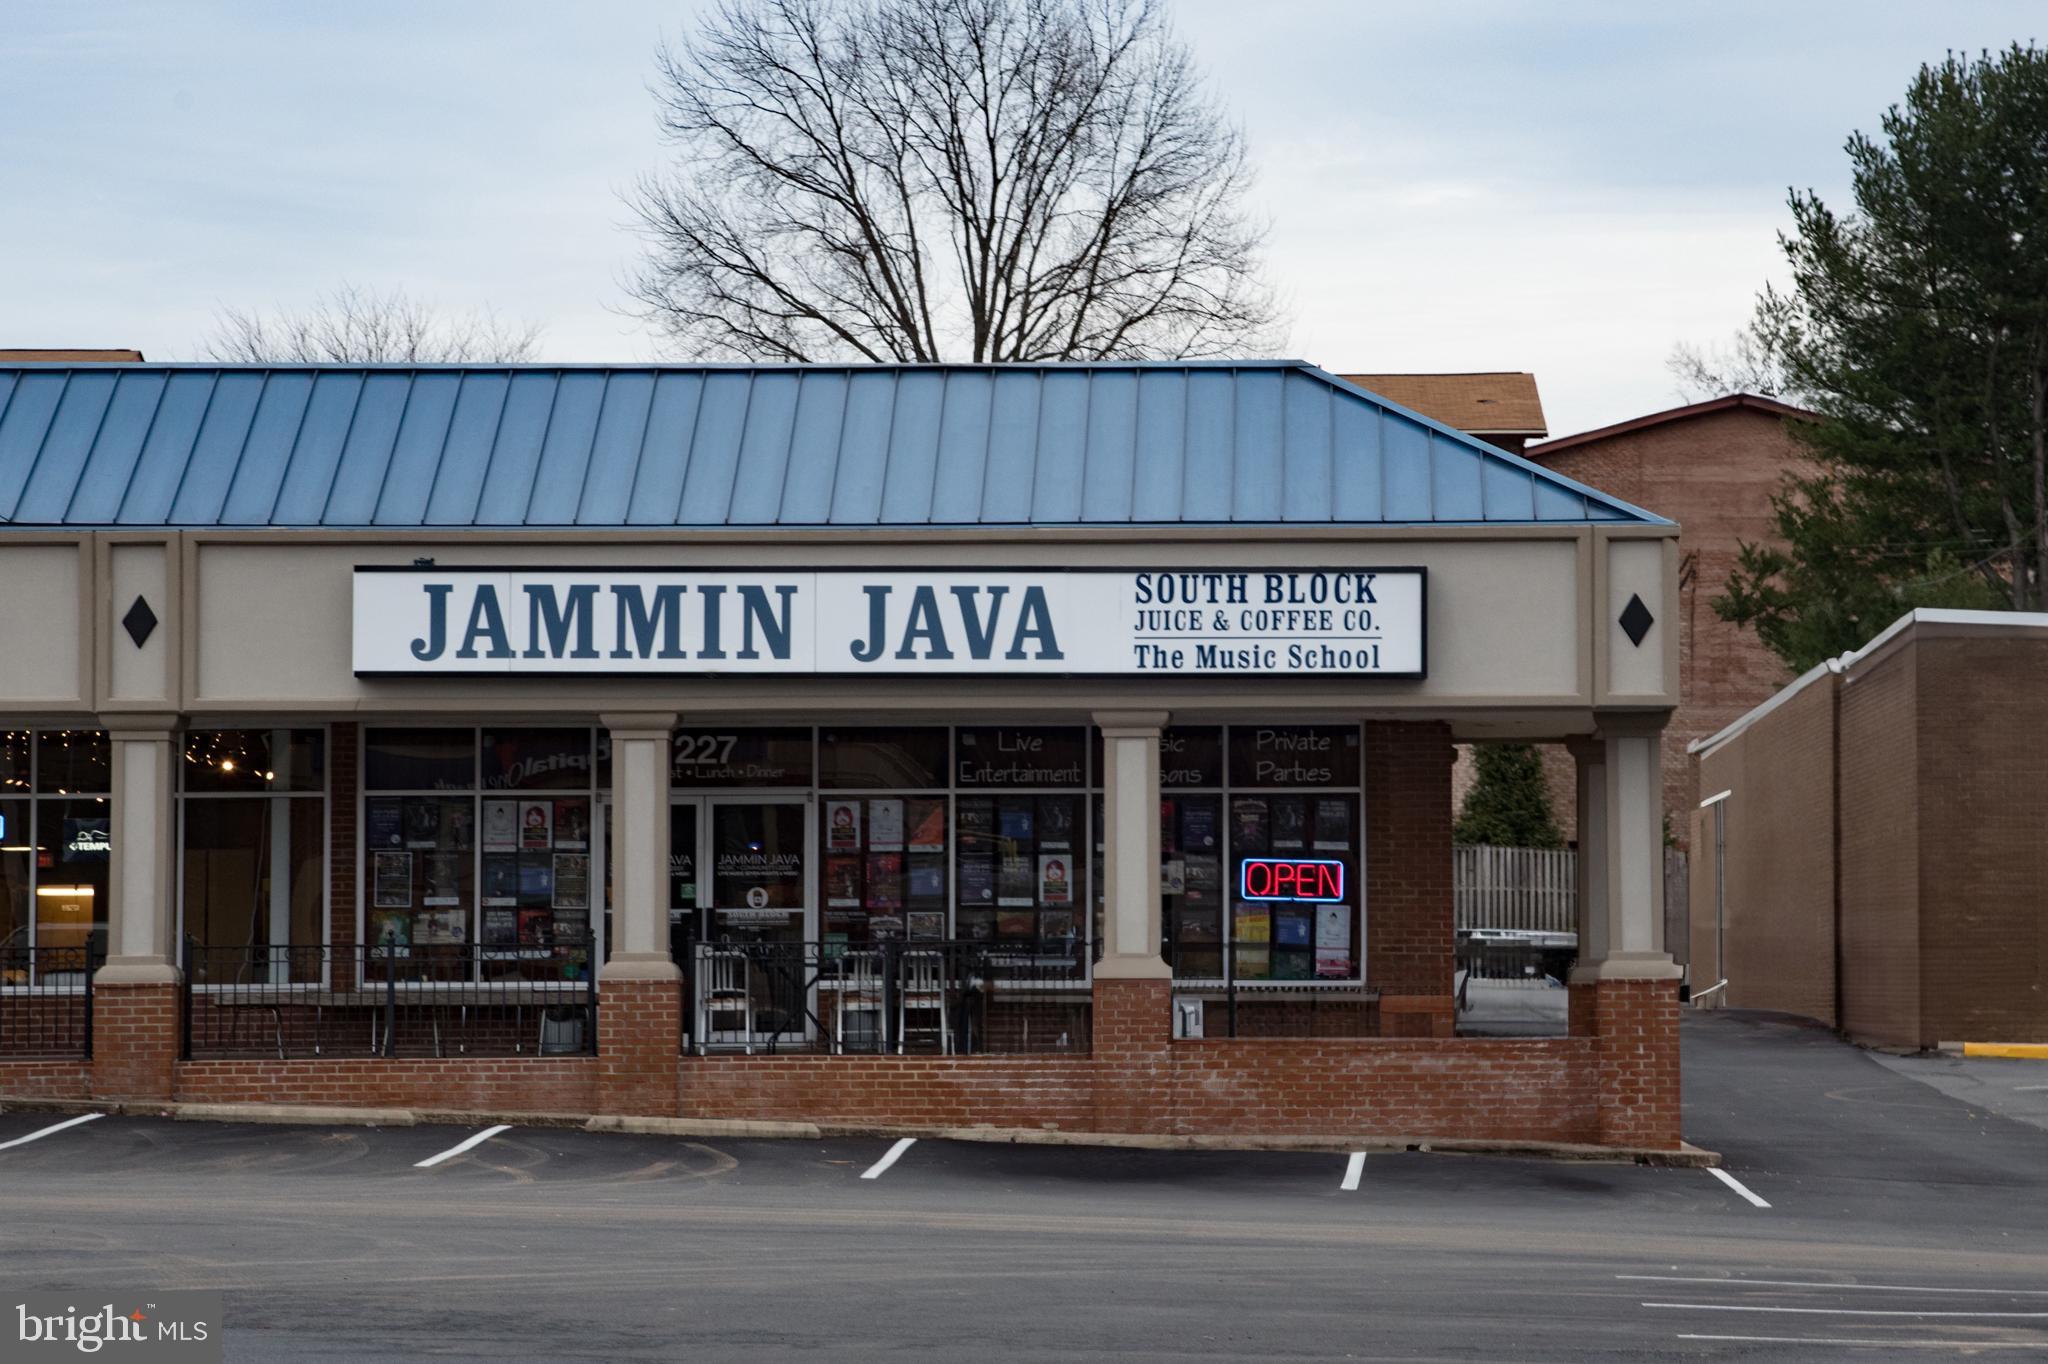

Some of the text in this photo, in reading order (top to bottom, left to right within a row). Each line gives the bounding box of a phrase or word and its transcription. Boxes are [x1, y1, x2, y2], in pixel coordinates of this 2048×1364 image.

[1134, 573, 1378, 605] SOUTH BLOCK
[410, 584, 1064, 663] JAMMIN JAVA
[1134, 609, 1381, 632] JUICE & COFFEE CO.
[1134, 644, 1381, 669] The Music School
[674, 736, 738, 764] 227
[998, 731, 1044, 752] Live
[1159, 735, 1186, 753] sic
[1255, 729, 1332, 752] Private
[695, 766, 735, 779] Lunch
[746, 765, 786, 779] Dinner
[959, 761, 1081, 783] Entertainment
[1255, 760, 1333, 783] Parties
[670, 854, 692, 866] AVA
[718, 854, 800, 865] JAMMIN JAVA
[1246, 862, 1342, 897] OPEN
